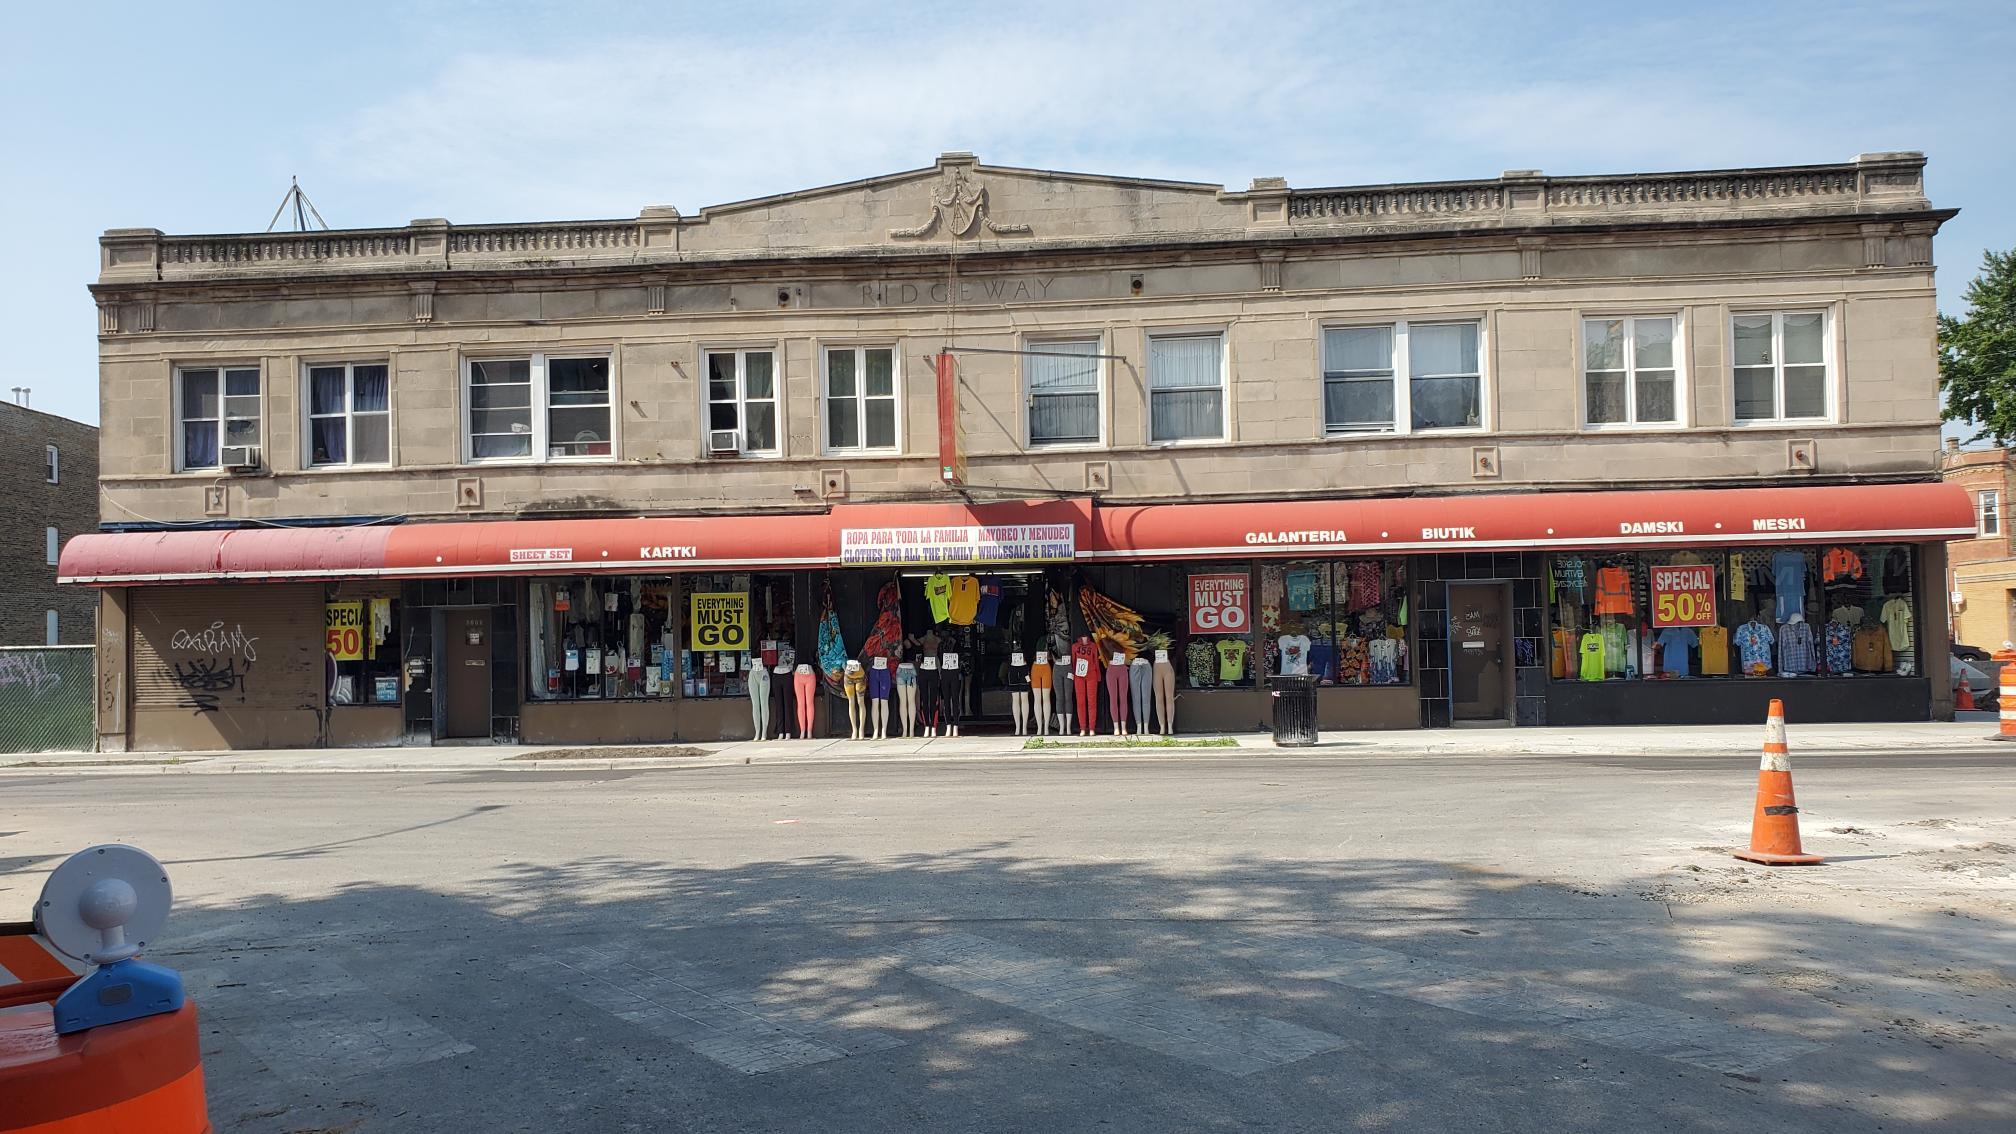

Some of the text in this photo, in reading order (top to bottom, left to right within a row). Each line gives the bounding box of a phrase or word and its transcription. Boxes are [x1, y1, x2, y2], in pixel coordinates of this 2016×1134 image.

[862, 278, 1055, 305] RIDGEWAY
[1620, 521, 1684, 534] DAMSKI
[1753, 518, 1806, 530] MESKI
[846, 526, 1070, 545] ROPA PARA TODA LA FAMILIA MAYOREO Y MENUDEO
[1245, 530, 1347, 544] GALANTERIA
[1422, 526, 1476, 540] BIUTIK
[512, 550, 570, 560] SHEET SET
[640, 546, 696, 559] KARTKI
[844, 544, 1072, 563] CLOTHES FOR ALL THE FAMILY WHOLESALE & RETAIL
[1195, 579, 1244, 591] EVERYTHING
[1656, 571, 1710, 591] SPECIAL
[698, 598, 744, 610] EVERYTHING
[1195, 591, 1244, 607] MUST
[1658, 592, 1711, 622] 50%
[326, 608, 365, 627] SPECIA
[698, 609, 744, 625] MUST
[1196, 606, 1245, 629] GO
[1696, 612, 1711, 620] OFF
[698, 624, 745, 646] GO
